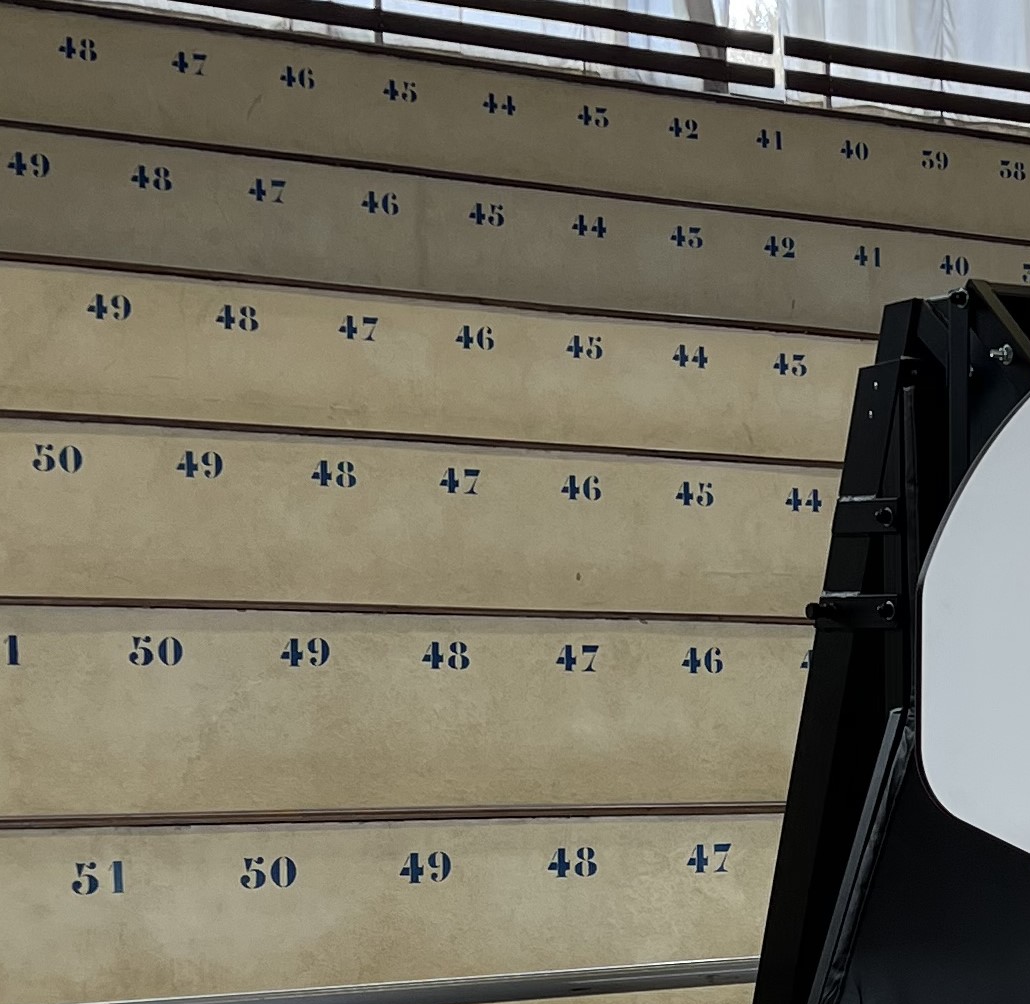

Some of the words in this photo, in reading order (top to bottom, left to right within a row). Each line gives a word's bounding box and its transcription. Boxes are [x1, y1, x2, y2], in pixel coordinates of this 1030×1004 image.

[58, 36, 98, 62] 48
[171, 51, 208, 76] 47
[279, 65, 315, 89] 46
[382, 79, 418, 103] 45
[482, 92, 516, 116] 44
[668, 117, 699, 140] 42
[756, 128, 782, 151] 41
[840, 139, 869, 161] 40
[7, 151, 50, 178] 49
[130, 165, 173, 191] 48
[248, 178, 287, 204] 47
[361, 190, 399, 216] 46
[468, 202, 505, 227] 45
[571, 214, 607, 239] 44
[763, 235, 795, 259] 42
[853, 245, 881, 268] 41
[939, 254, 970, 276] 40
[86, 293, 132, 320] 49
[215, 304, 259, 332] 48
[338, 314, 379, 342] 47
[455, 325, 495, 351] 46
[565, 335, 603, 360] 45
[672, 344, 708, 369] 44
[32, 443, 83, 473] 50
[176, 450, 223, 479] 49
[310, 459, 357, 488] 48
[439, 467, 481, 495] 47
[560, 474, 602, 501] 46
[675, 481, 714, 507] 45
[784, 487, 823, 513] 44
[128, 635, 183, 666] 50
[280, 637, 330, 668] 49
[421, 641, 470, 670] 48
[555, 644, 600, 673] 47
[681, 647, 724, 674] 46
[71, 860, 125, 896] 51
[239, 856, 297, 890] 50
[399, 851, 452, 884] 49
[547, 846, 598, 878] 48
[686, 843, 732, 874] 47
